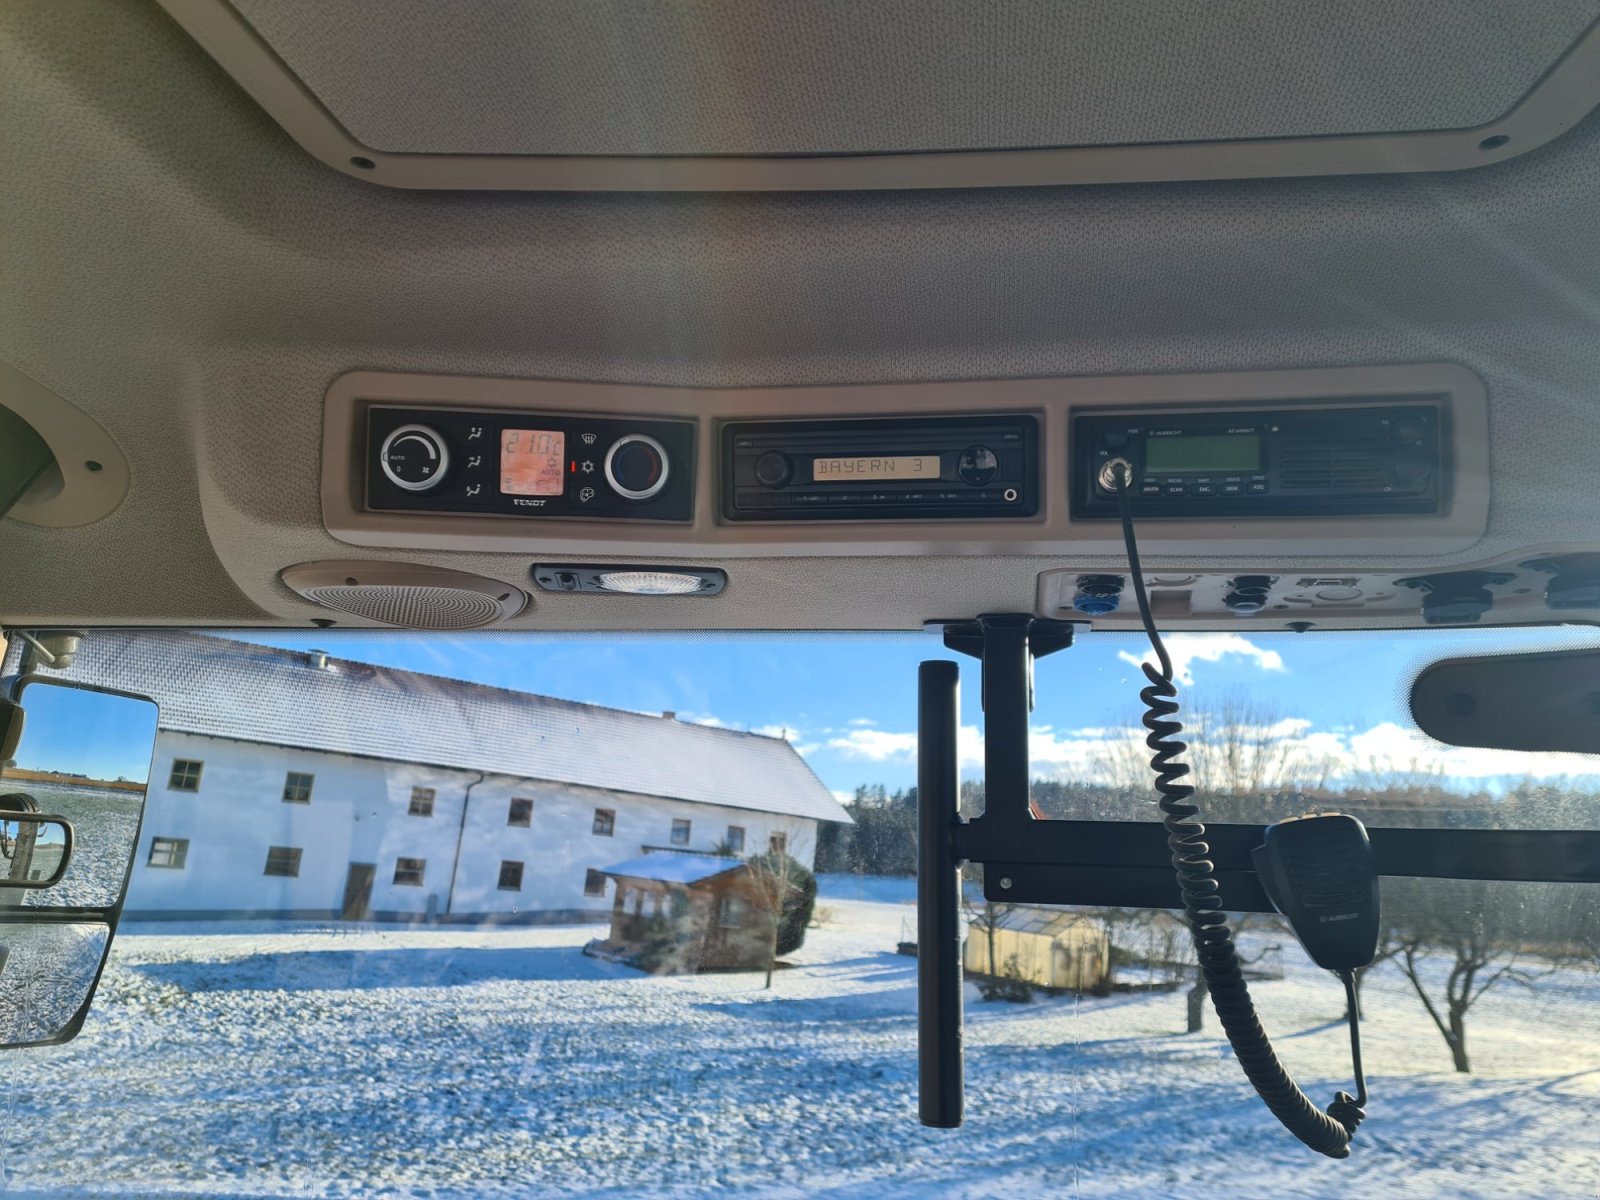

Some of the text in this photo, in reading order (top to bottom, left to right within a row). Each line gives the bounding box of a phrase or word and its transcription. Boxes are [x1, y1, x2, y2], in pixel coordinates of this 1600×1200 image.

[818, 458, 923, 474] BAYERN 3
[513, 498, 547, 507] FENDT
